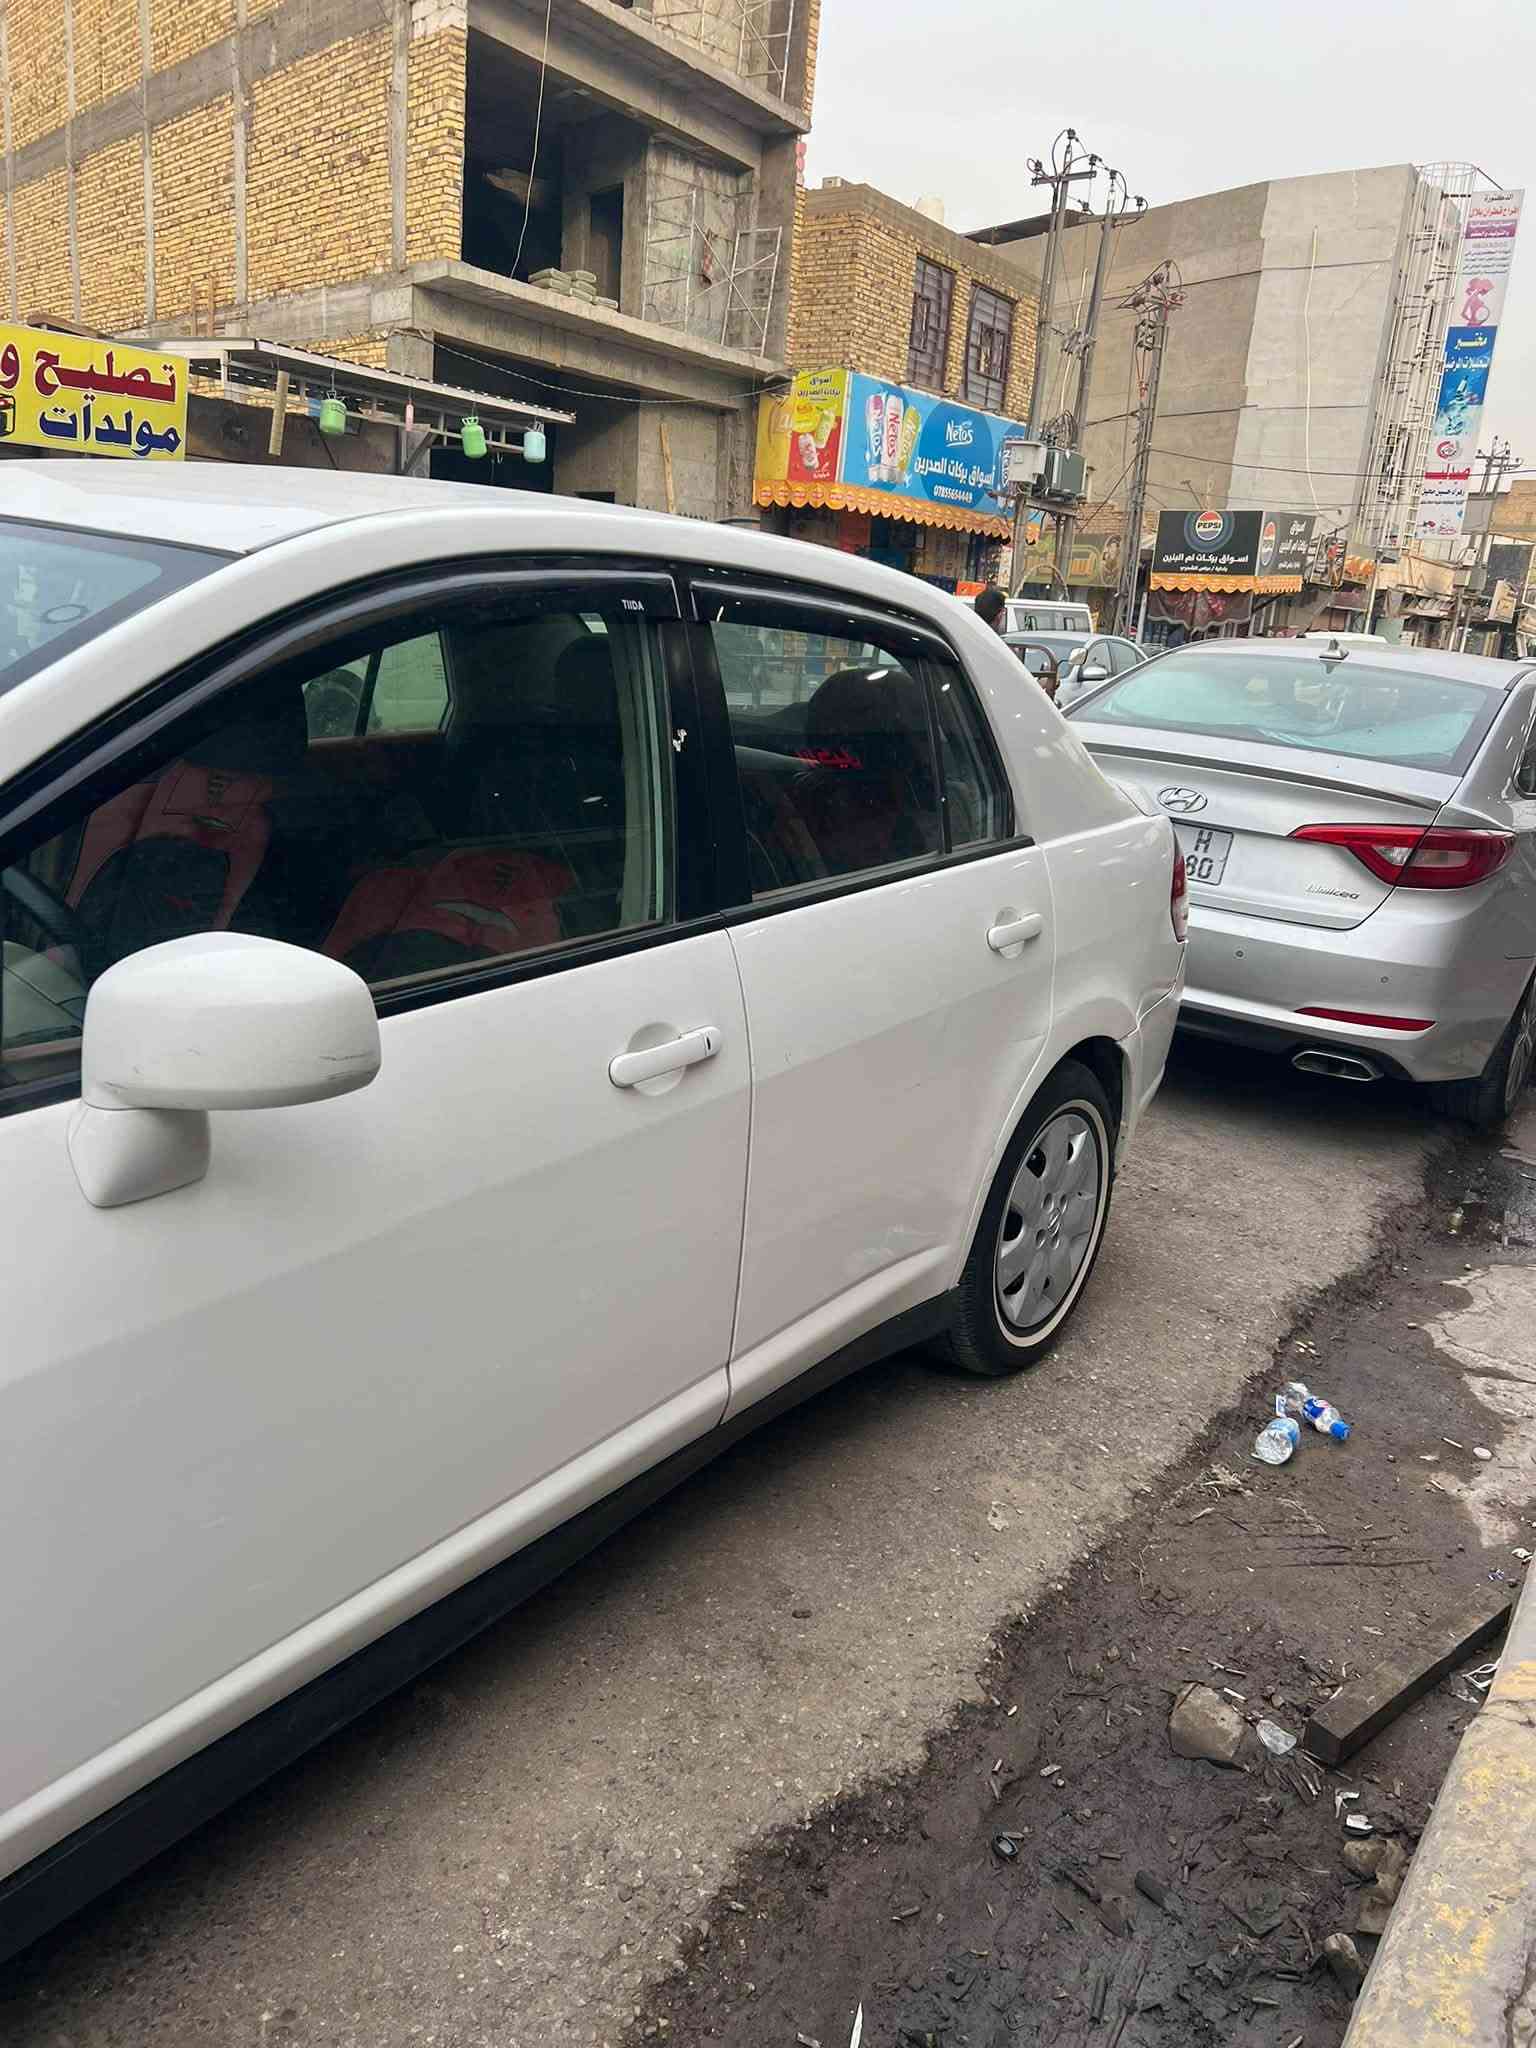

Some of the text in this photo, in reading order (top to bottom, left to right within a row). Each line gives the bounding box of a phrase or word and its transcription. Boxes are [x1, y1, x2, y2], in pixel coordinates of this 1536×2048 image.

[1454, 332, 1487, 350] مختبر
[35, 351, 176, 402] تصليح
[39, 403, 182, 457] مولدات
[888, 412, 901, 458] Netos
[945, 420, 973, 446] Netos
[914, 456, 947, 476] الصدرين
[947, 459, 968, 484] بركات
[1184, 553, 1195, 563] ام
[1195, 552, 1218, 564] بركات
[1218, 553, 1249, 565] اسواق
[621, 599, 645, 612] TIIDA
[1194, 829, 1214, 853] H
[1186, 854, 1213, 879] 80
